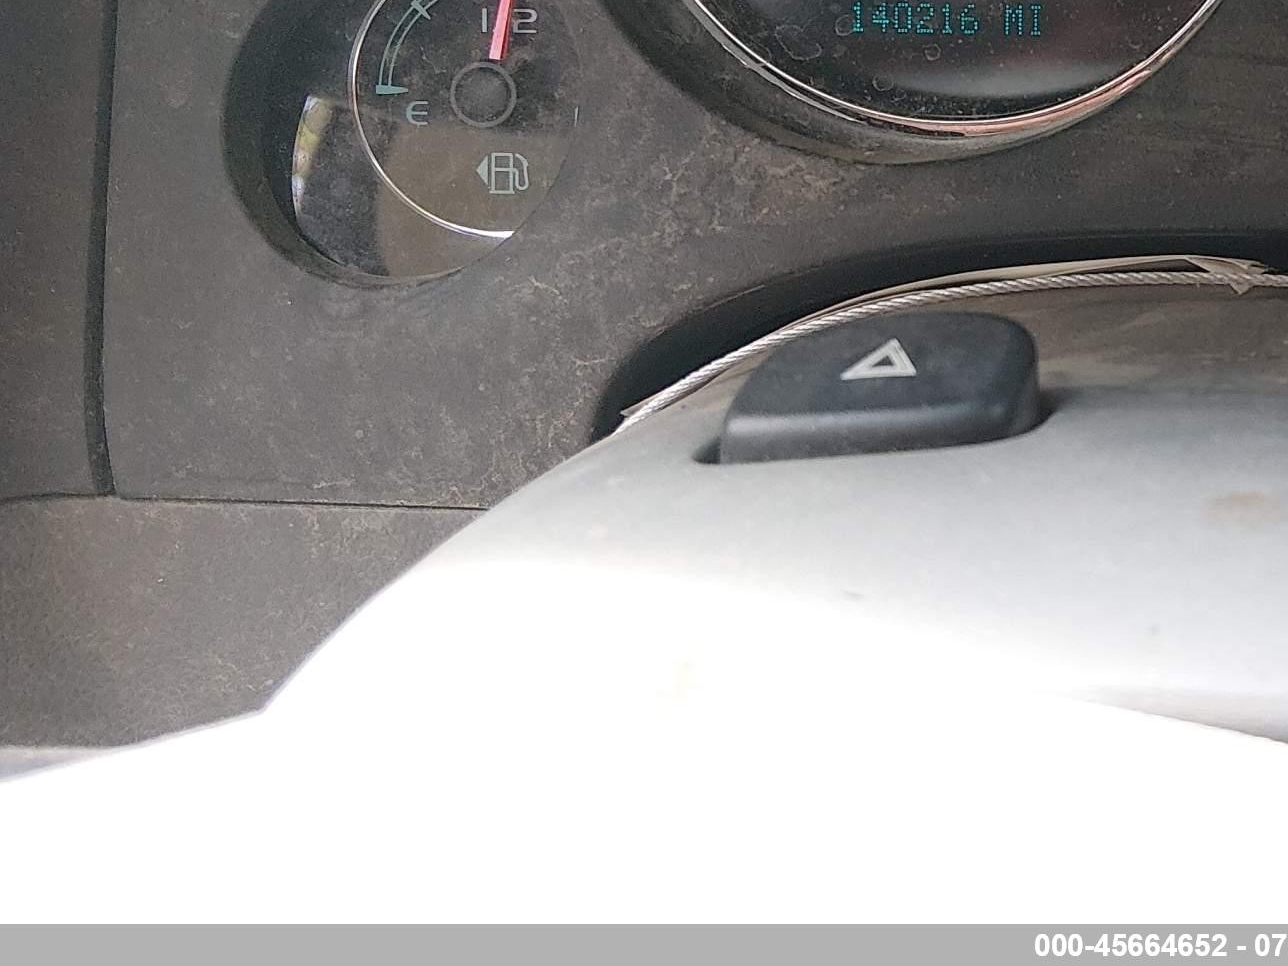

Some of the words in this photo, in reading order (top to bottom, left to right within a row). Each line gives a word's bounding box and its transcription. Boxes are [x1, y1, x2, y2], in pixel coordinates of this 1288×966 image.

[852, 1, 979, 35] 140216
[1004, 4, 1041, 35] MI
[406, 101, 428, 125] E
